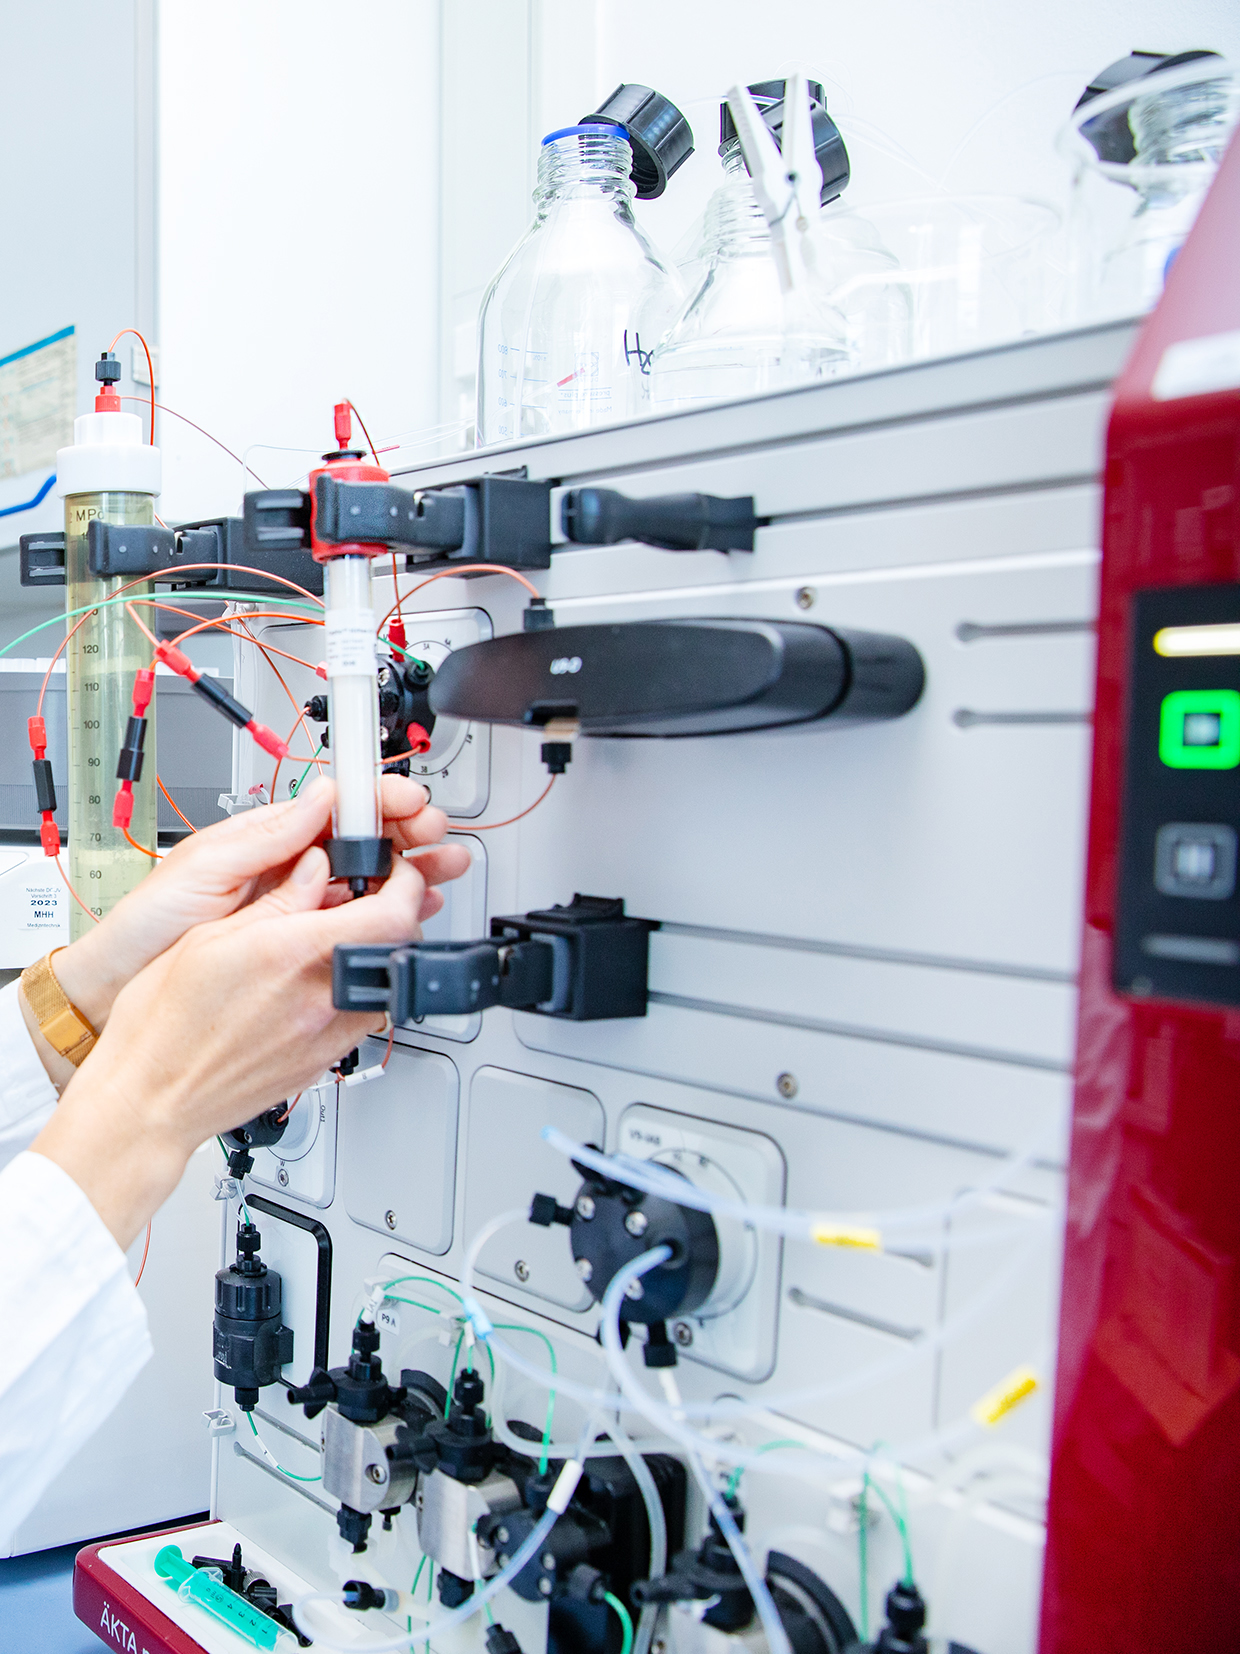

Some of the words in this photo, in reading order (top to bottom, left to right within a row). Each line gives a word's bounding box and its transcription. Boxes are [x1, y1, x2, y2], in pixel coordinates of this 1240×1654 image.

[82, 644, 99, 654] 120
[84, 682, 100, 692] 110
[83, 720, 100, 729] 100
[87, 758, 101, 767] 90
[88, 795, 101, 805] 80
[89, 832, 102, 842] 70
[89, 870, 102, 880] 60
[34, 910, 54, 918] MHH
[381, 1312, 390, 1324] P9
[100, 1601, 137, 1654] ÄKTA
